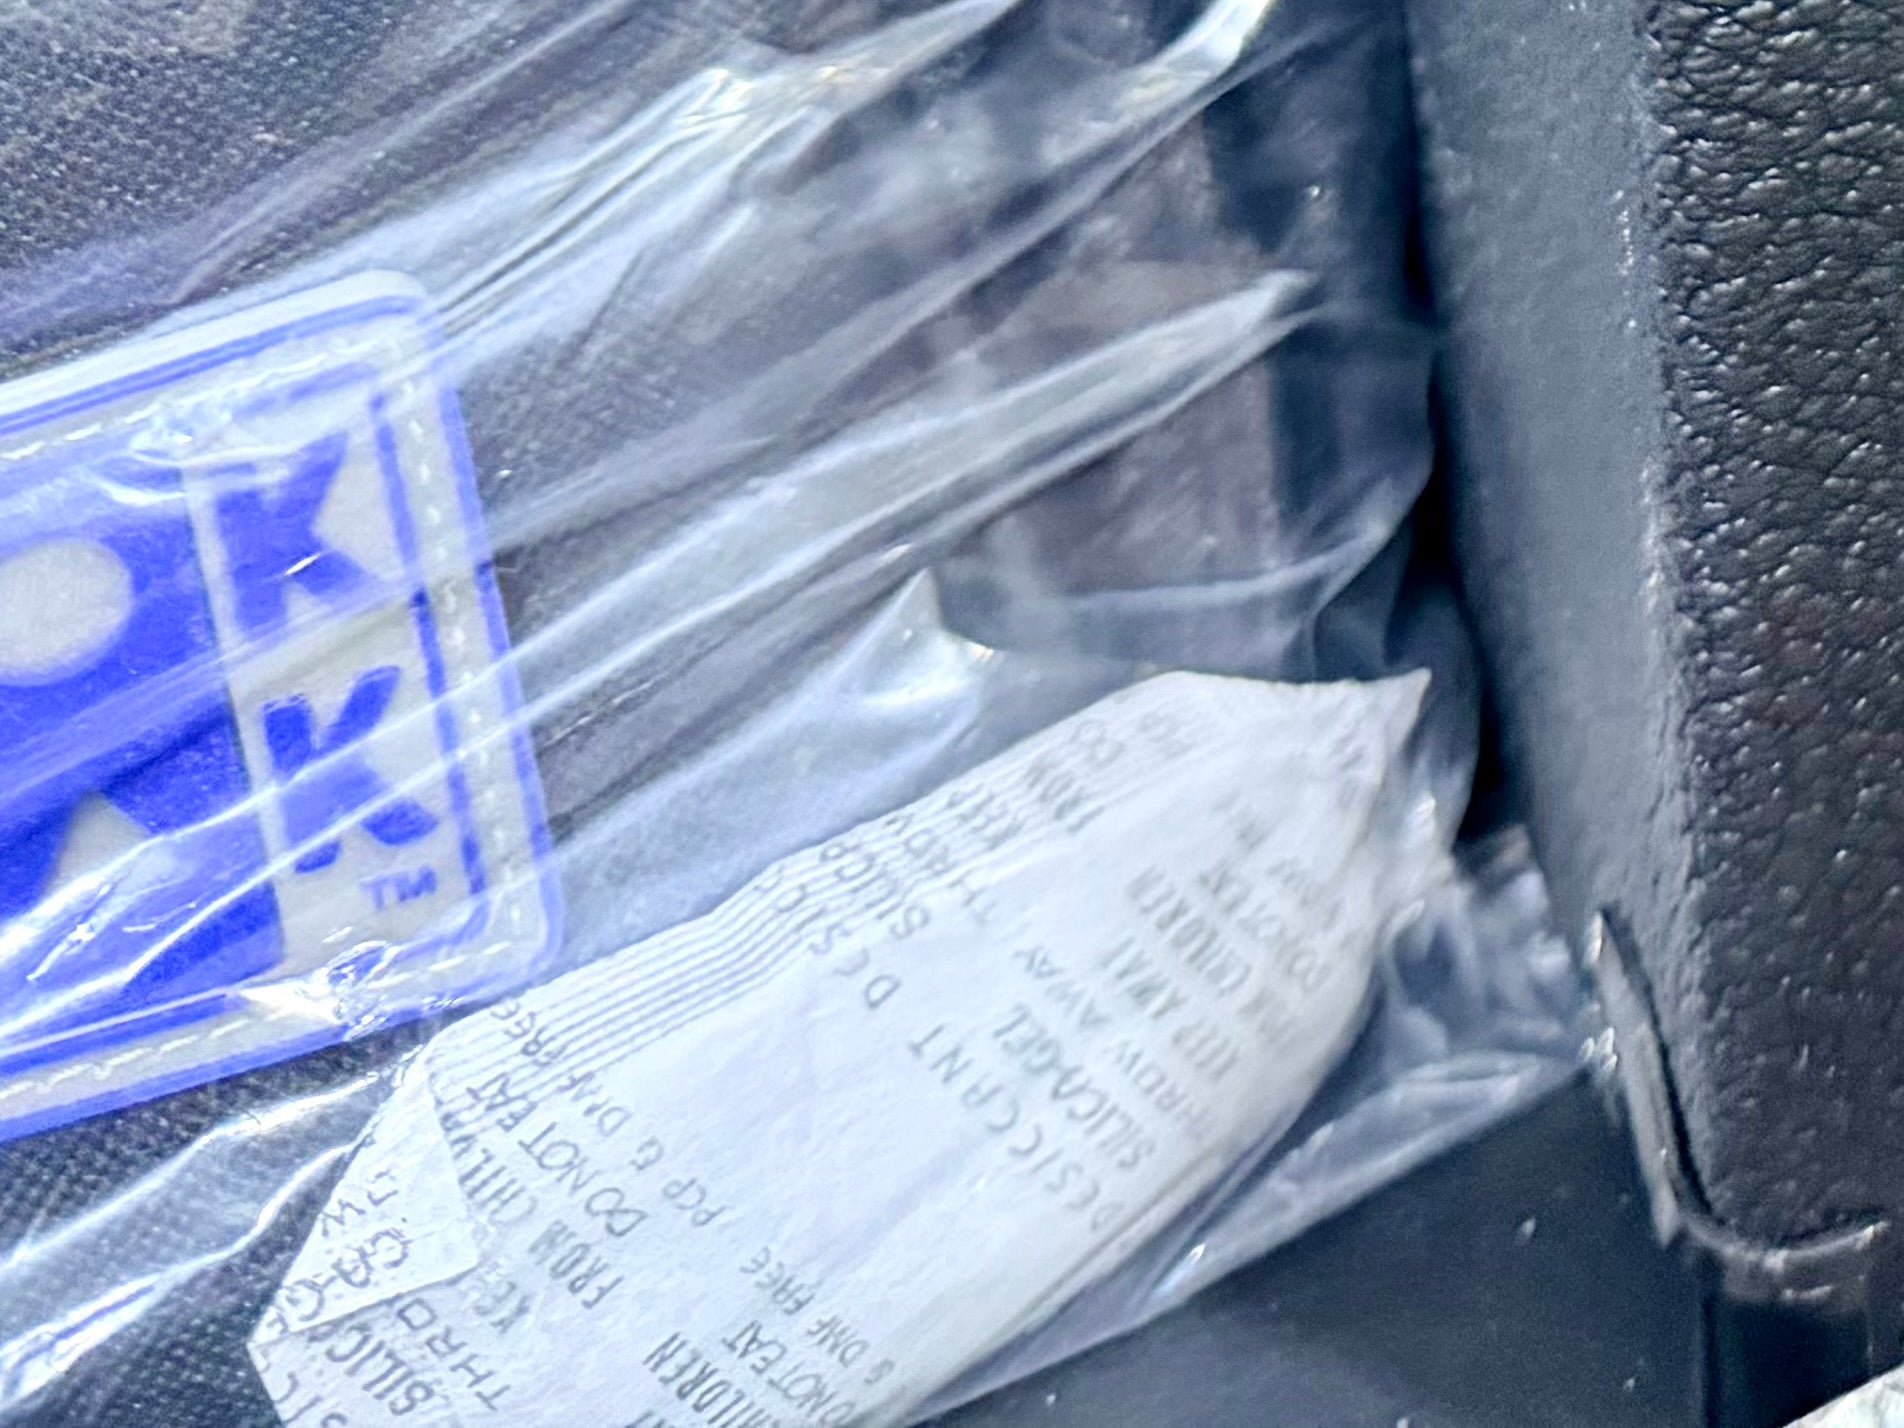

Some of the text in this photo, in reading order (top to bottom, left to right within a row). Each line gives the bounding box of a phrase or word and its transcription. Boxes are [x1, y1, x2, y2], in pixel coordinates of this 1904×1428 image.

[358, 864, 440, 914] TM
[1004, 931, 1118, 1045] AWAY
[482, 987, 571, 1075] FREE
[554, 1058, 637, 1140] DMF
[900, 1012, 1128, 1240] DESICCANT
[983, 997, 1164, 1178] SILICA-GEL
[460, 1058, 650, 1246] DO NOT EAT
[656, 1162, 730, 1235] PCP
[521, 1212, 626, 1316] FROM
[736, 1240, 819, 1322] FREE
[717, 1308, 791, 1381] EAT
[803, 1303, 873, 1374] DMF
[762, 1348, 840, 1425] NOT
